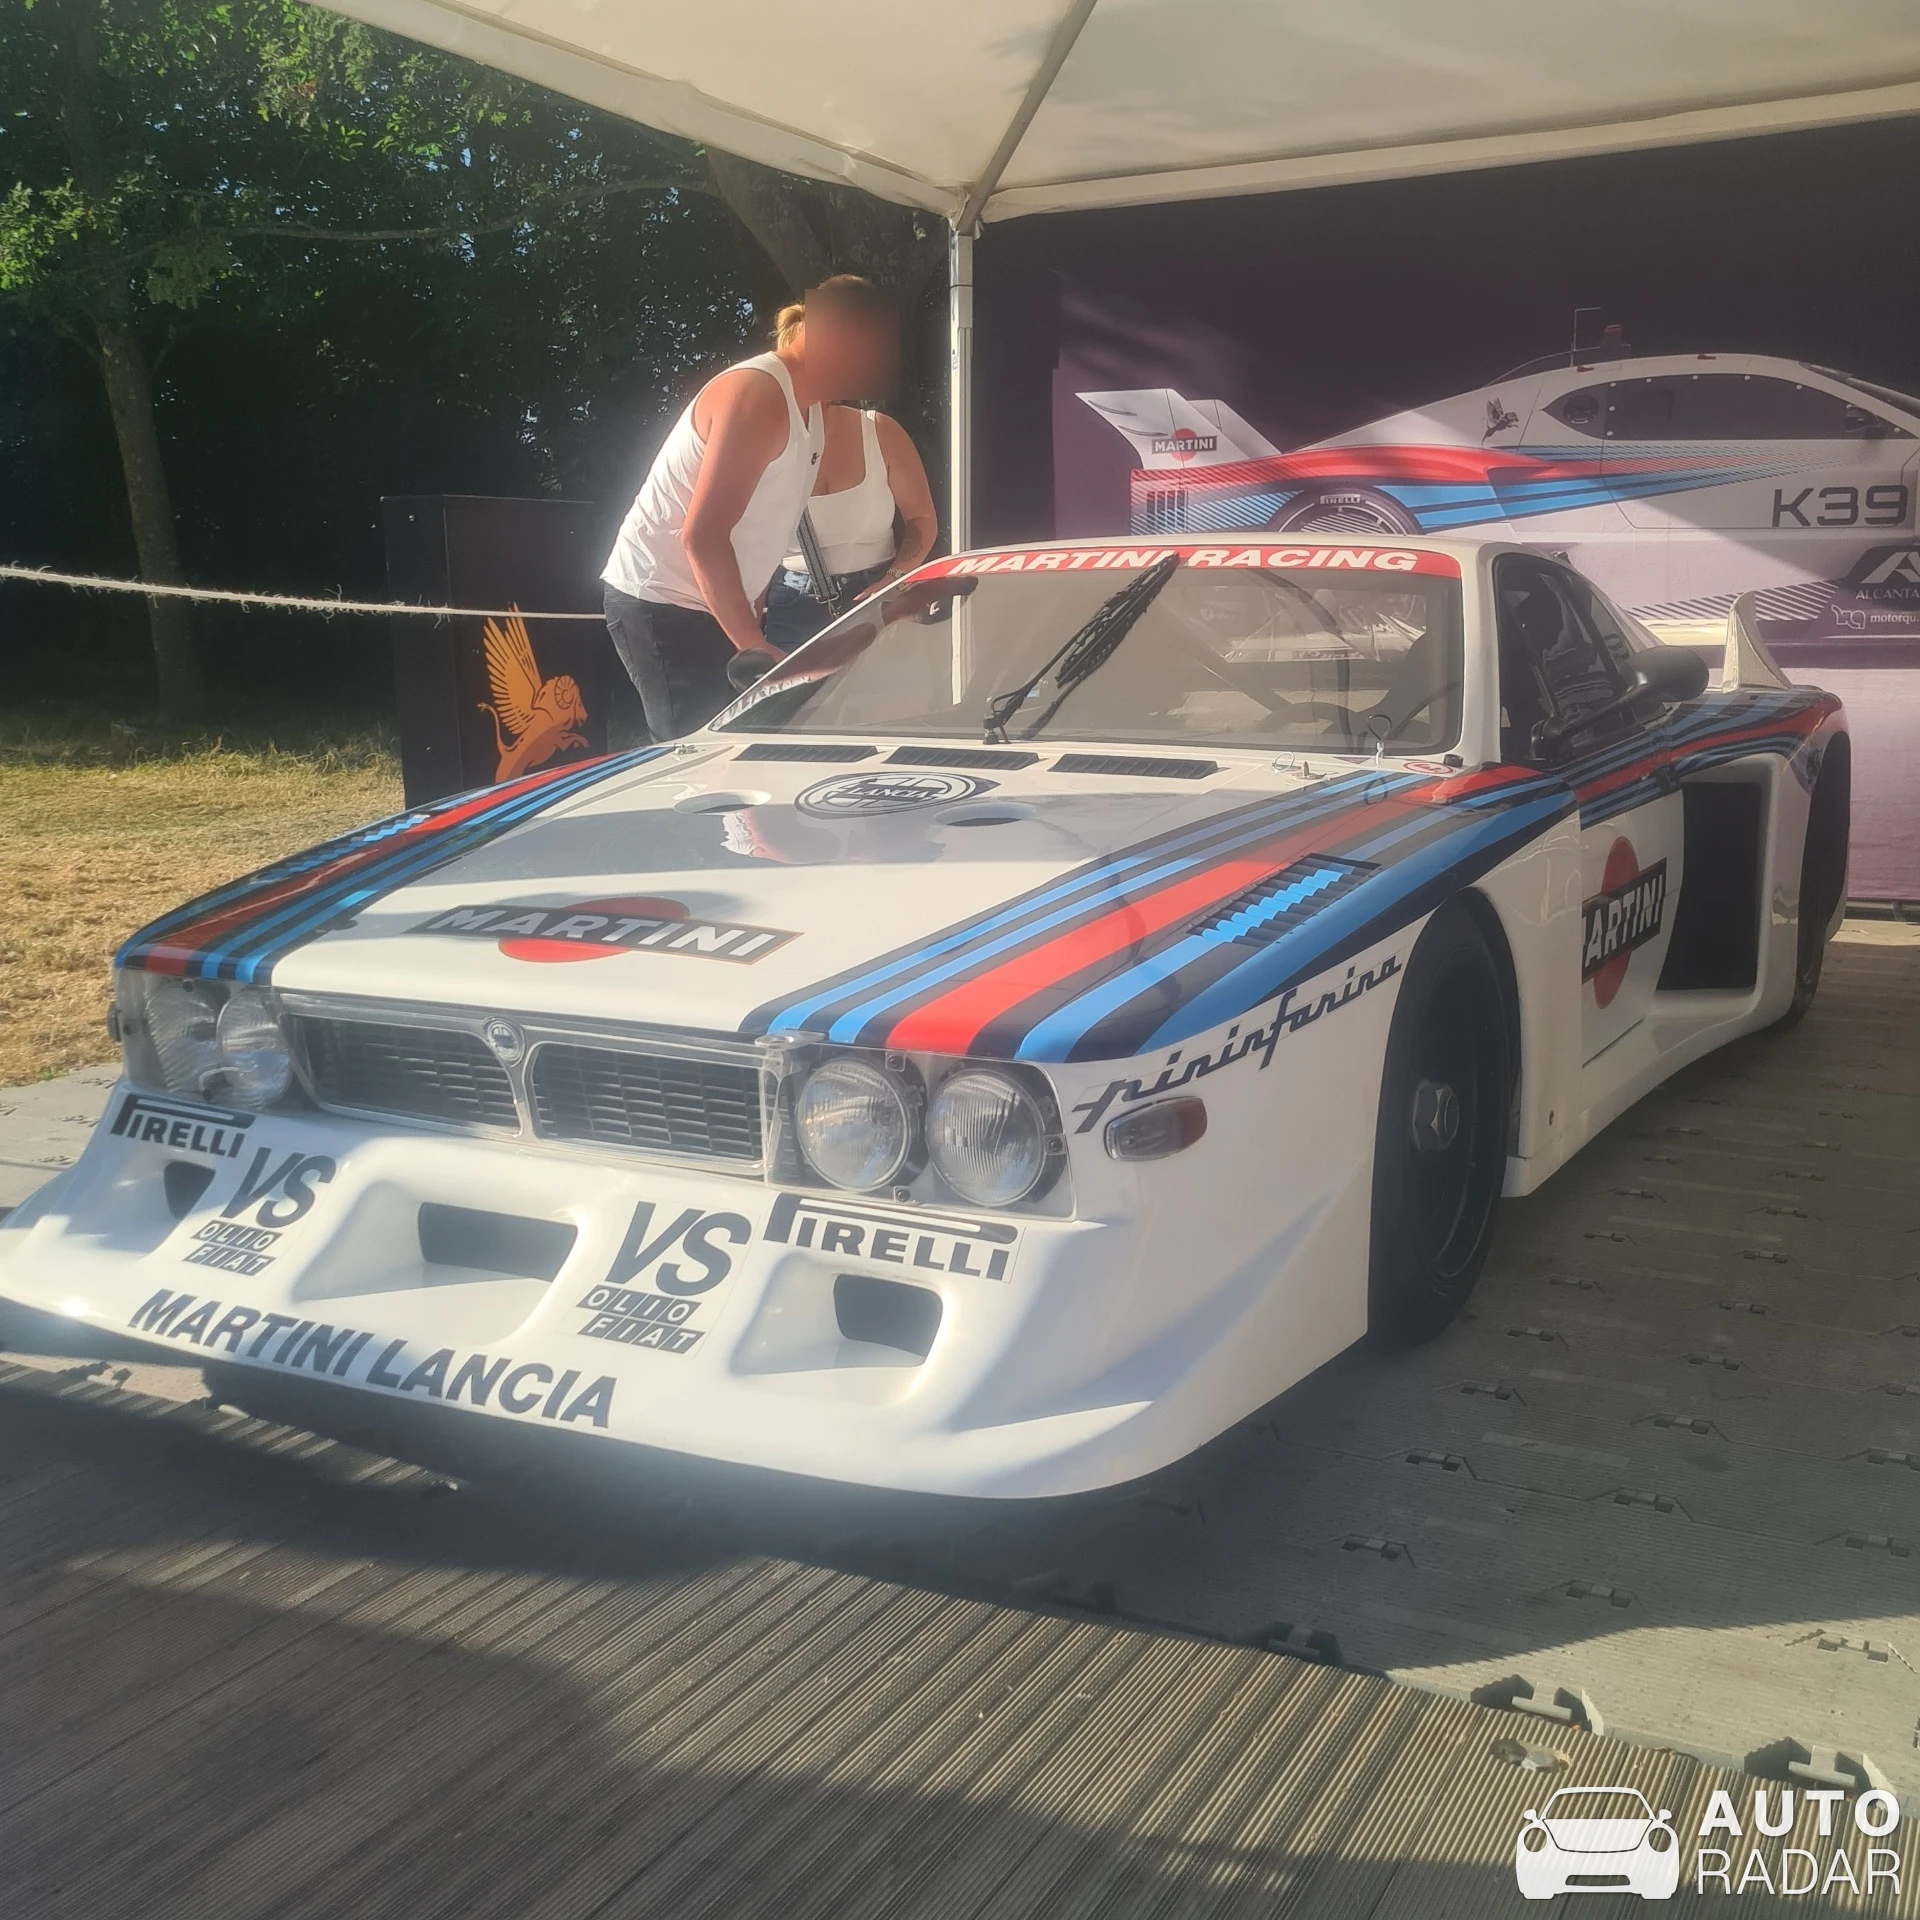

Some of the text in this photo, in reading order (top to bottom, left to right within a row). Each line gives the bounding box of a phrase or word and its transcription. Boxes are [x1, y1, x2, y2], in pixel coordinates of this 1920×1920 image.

[1155, 439, 1214, 452] MARTINI
[1772, 485, 1908, 527] K39
[947, 550, 1418, 576] MARTINI RACING
[853, 786, 932, 801] LANCIA
[427, 909, 776, 957] MARTINI
[1582, 874, 1663, 968] ARTINI
[1072, 954, 1402, 1134] pininfarina
[110, 1093, 256, 1158] PIRELLI
[219, 1147, 336, 1229] VS
[199, 1222, 276, 1251] OLIO
[605, 1201, 751, 1296] VS
[763, 1192, 1017, 1280] PIRELLI
[189, 1247, 268, 1275] FIAT
[586, 1288, 689, 1324] OLIO
[588, 1317, 696, 1351] FIAT
[129, 1289, 618, 1429] MARTINI LANCIA
